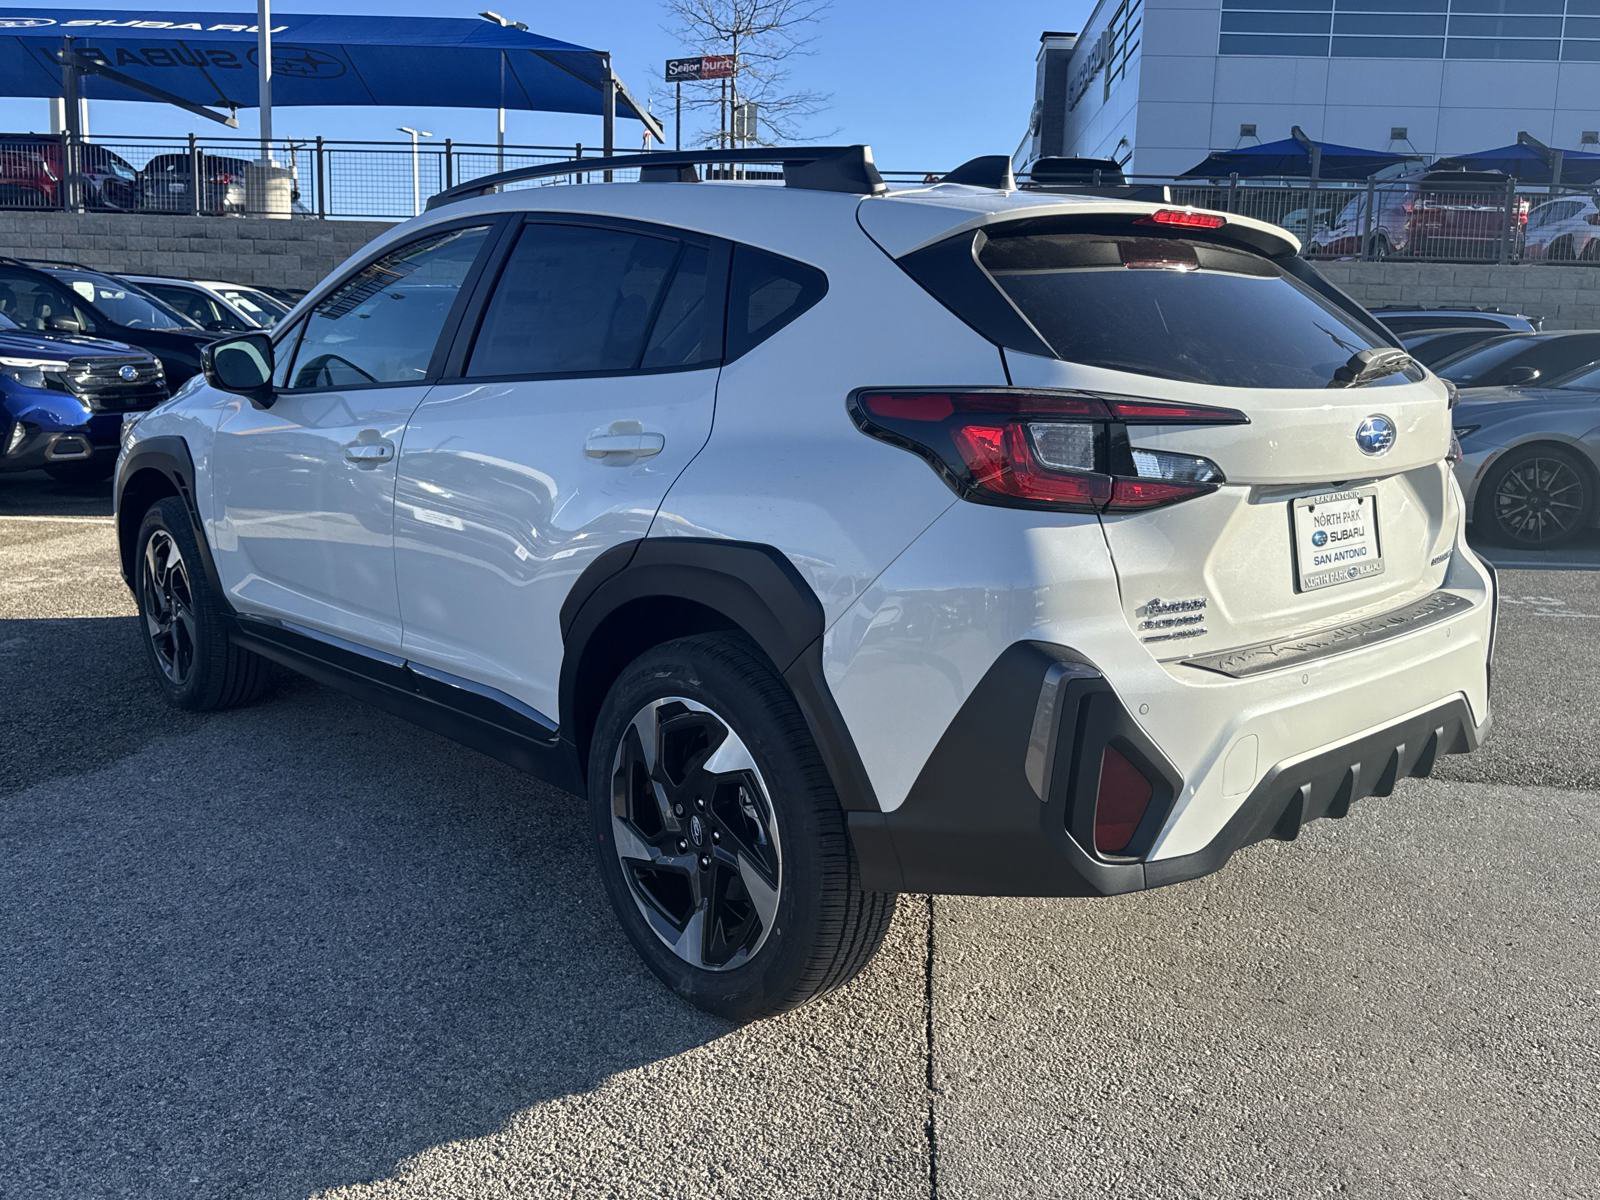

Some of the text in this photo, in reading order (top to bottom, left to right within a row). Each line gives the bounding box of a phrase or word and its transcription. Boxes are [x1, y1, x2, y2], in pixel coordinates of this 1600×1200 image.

[60, 19, 289, 33] SUBARU
[1314, 509, 1361, 527] NORTH PARK
[1330, 526, 1365, 543] SUBARU
[1313, 546, 1367, 566] SAN ANTONIO
